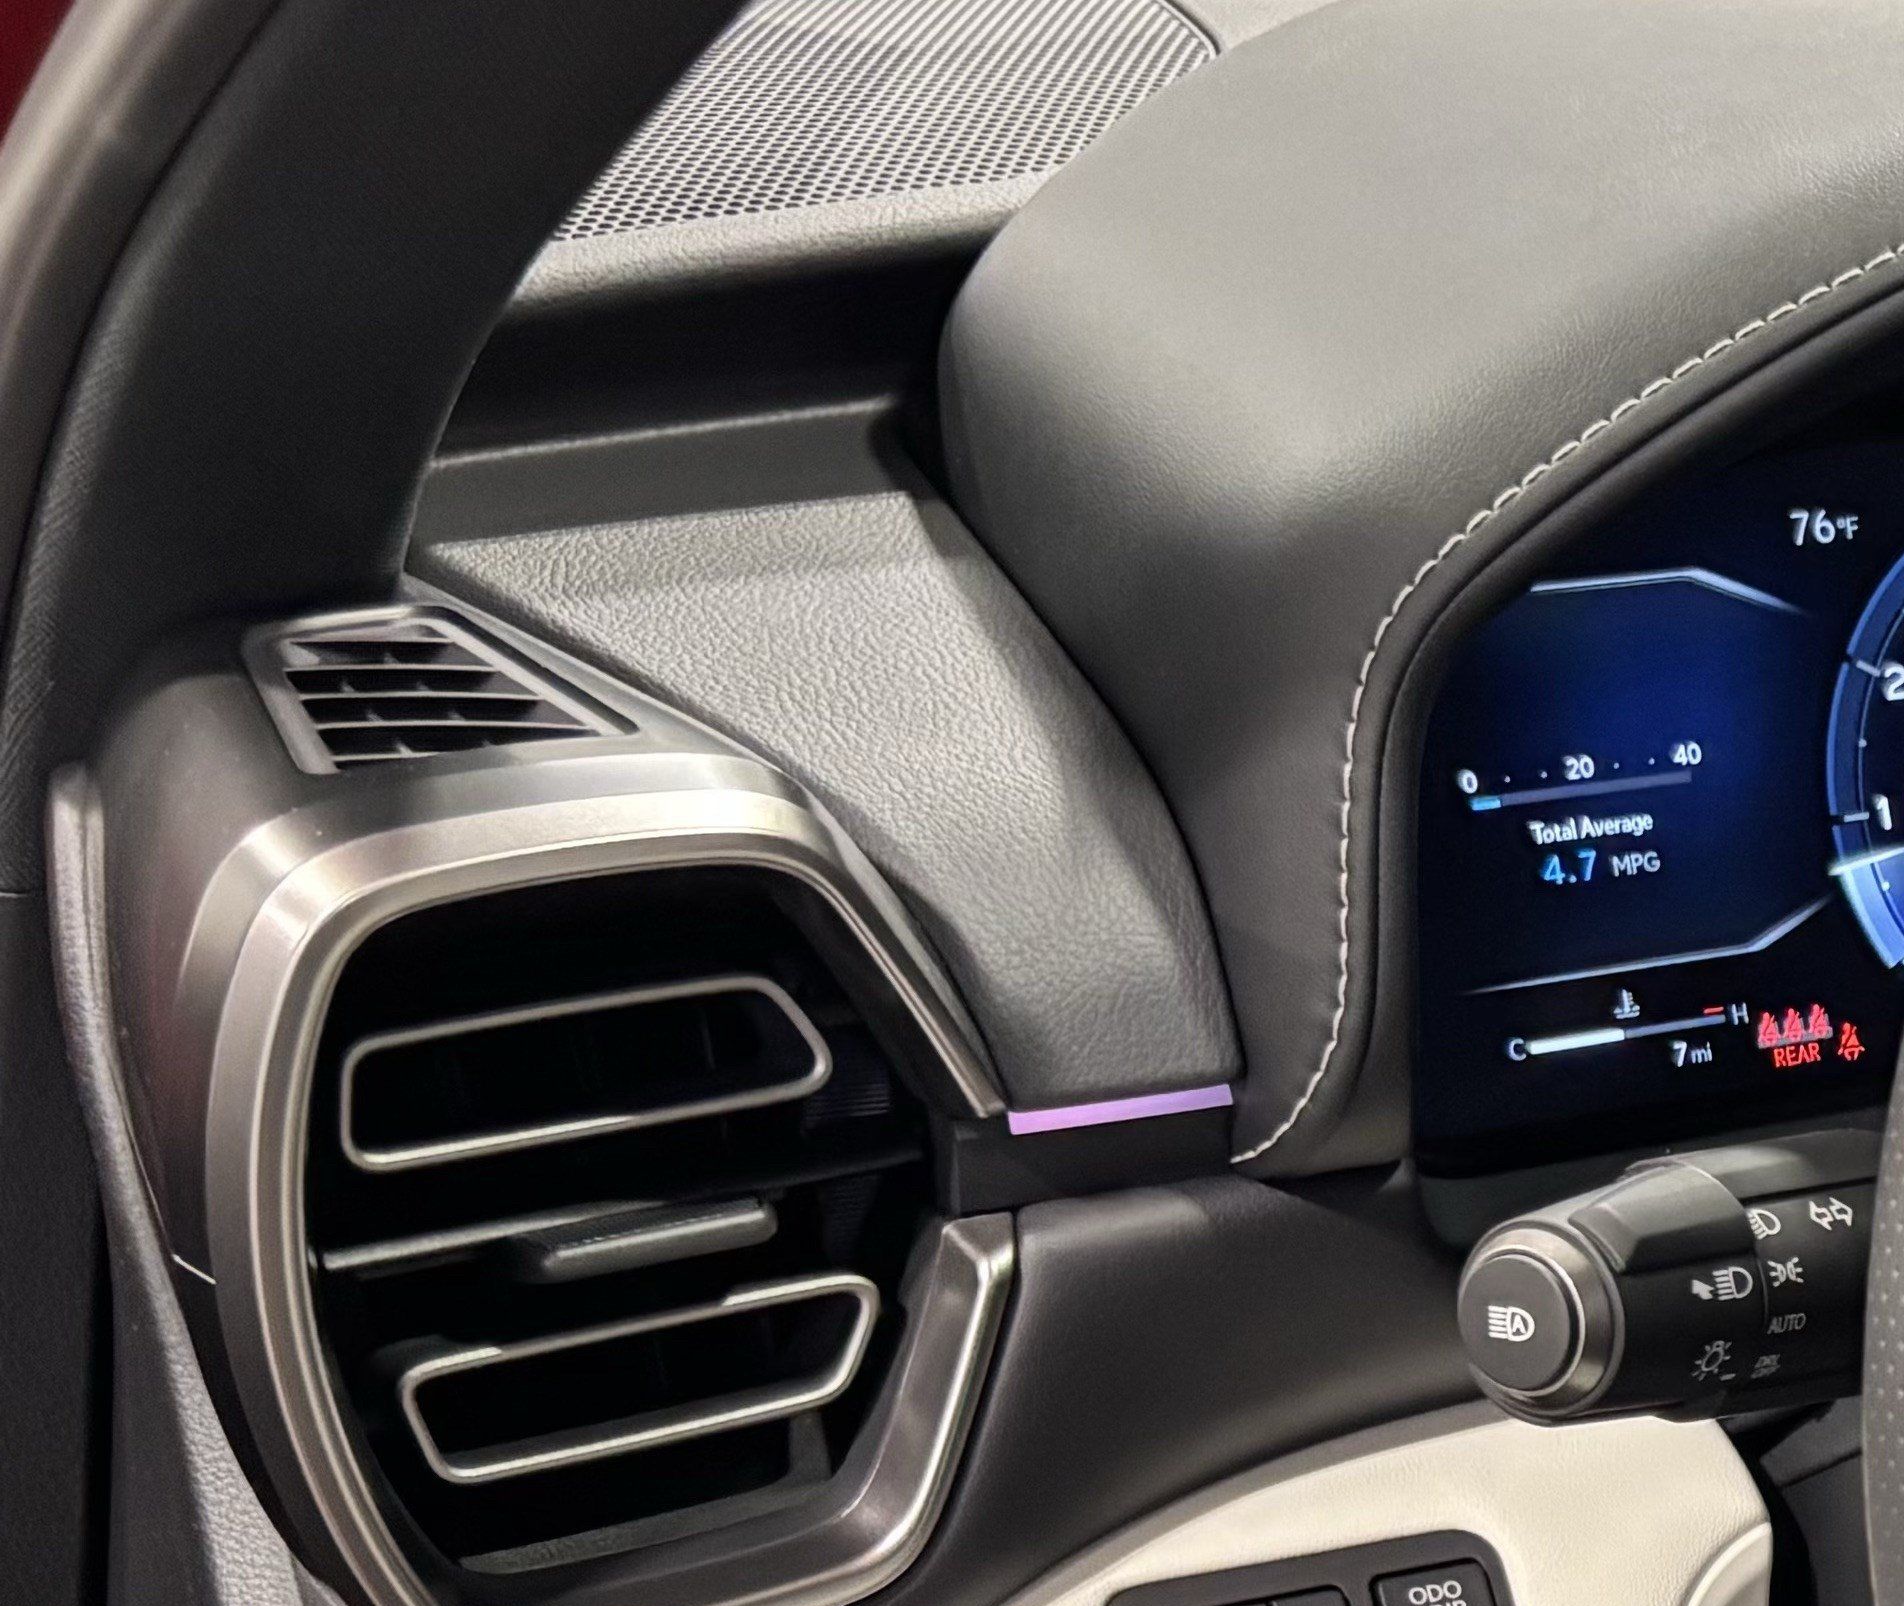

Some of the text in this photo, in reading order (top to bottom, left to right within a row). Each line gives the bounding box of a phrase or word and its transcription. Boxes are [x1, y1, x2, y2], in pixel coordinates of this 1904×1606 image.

[1457, 741, 1703, 796] 0 20 40
[1876, 795, 1893, 829] 1
[1528, 811, 1654, 845] Total Average
[1542, 851, 1662, 886] 4.7 MPG
[1730, 1004, 1749, 1026] H
[1508, 1038, 1527, 1061] C
[1673, 1041, 1713, 1067] 7 mi
[1773, 1042, 1821, 1067] REAR
[1767, 1313, 1806, 1335] AUTO
[1408, 1580, 1462, 1606] ODO
